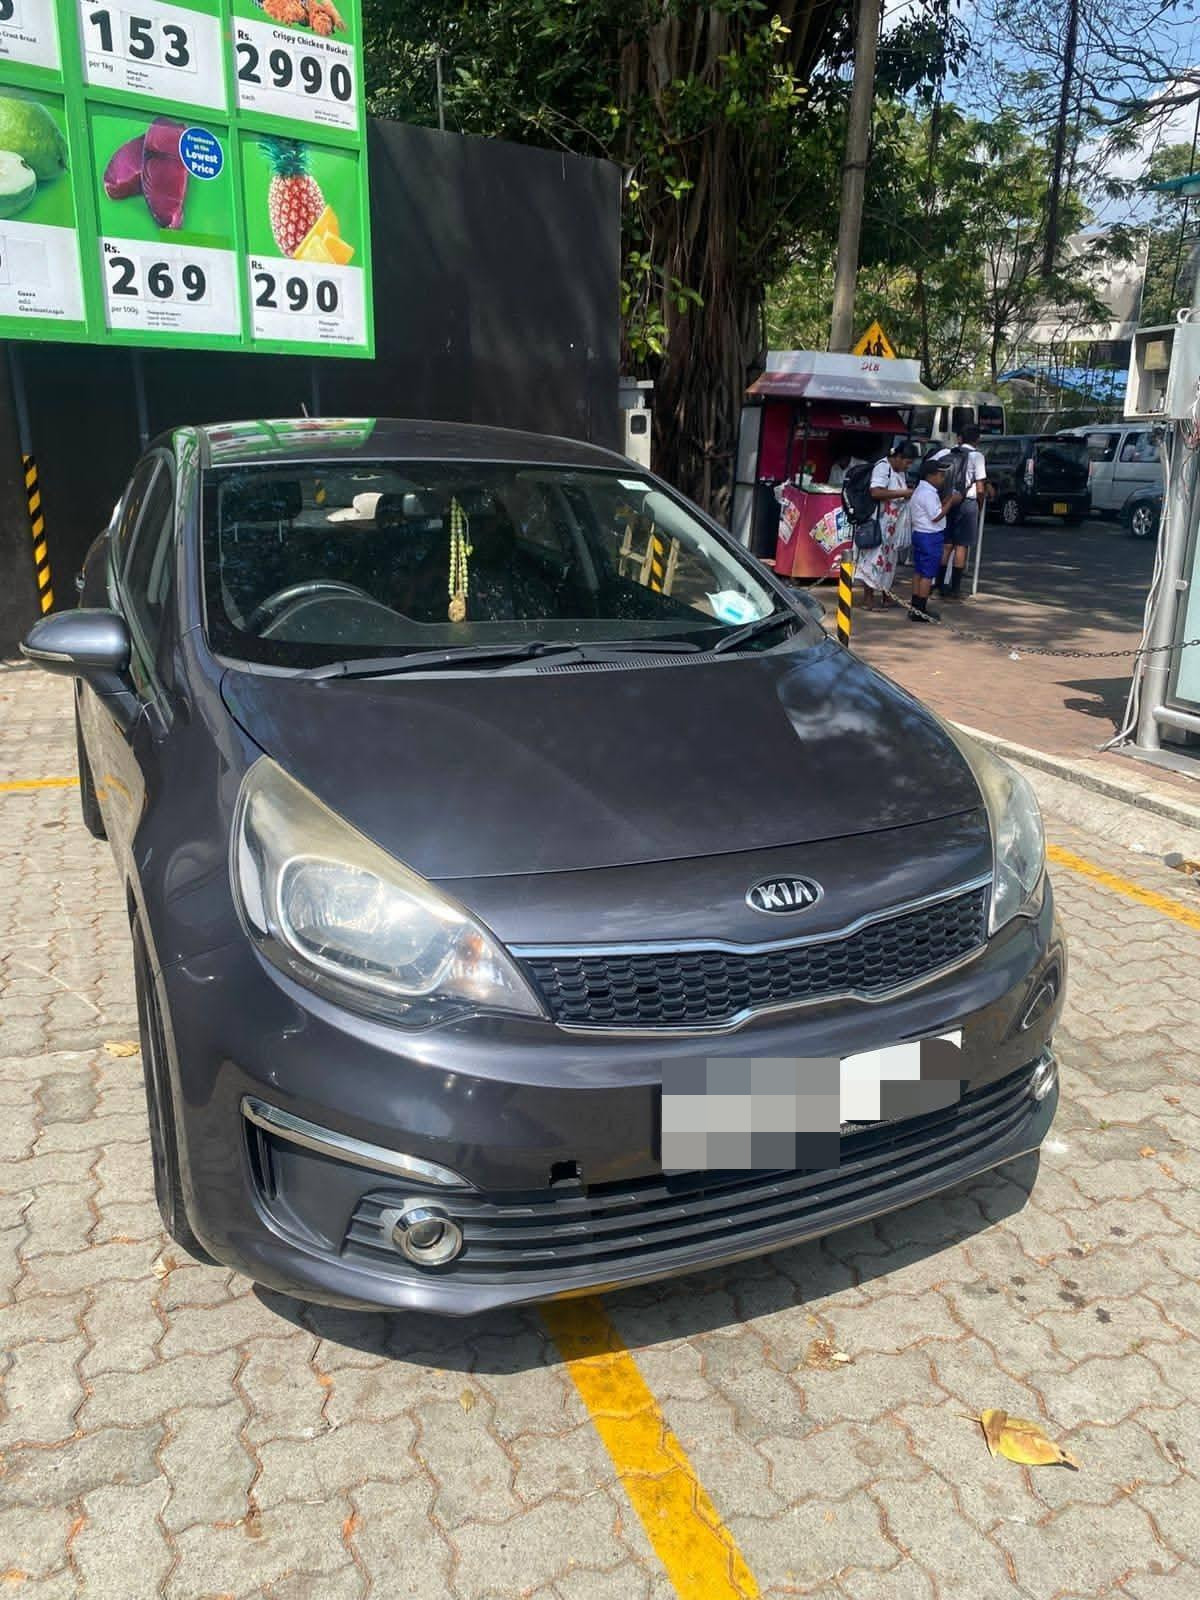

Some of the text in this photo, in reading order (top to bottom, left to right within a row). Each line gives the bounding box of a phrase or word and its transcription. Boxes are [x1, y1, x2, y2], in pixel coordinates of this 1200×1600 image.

[90, 9, 190, 67] 153
[237, 30, 252, 41] Rs.
[272, 30, 348, 56] Crispy Chicken Bucket
[235, 43, 352, 102] 2990
[186, 147, 218, 164] Lowest
[191, 161, 214, 175] Price
[104, 243, 120, 254] Rs.
[251, 260, 265, 270] Rs.
[108, 257, 206, 302] 269
[254, 273, 338, 313] 290
[757, 881, 813, 909] KIA
